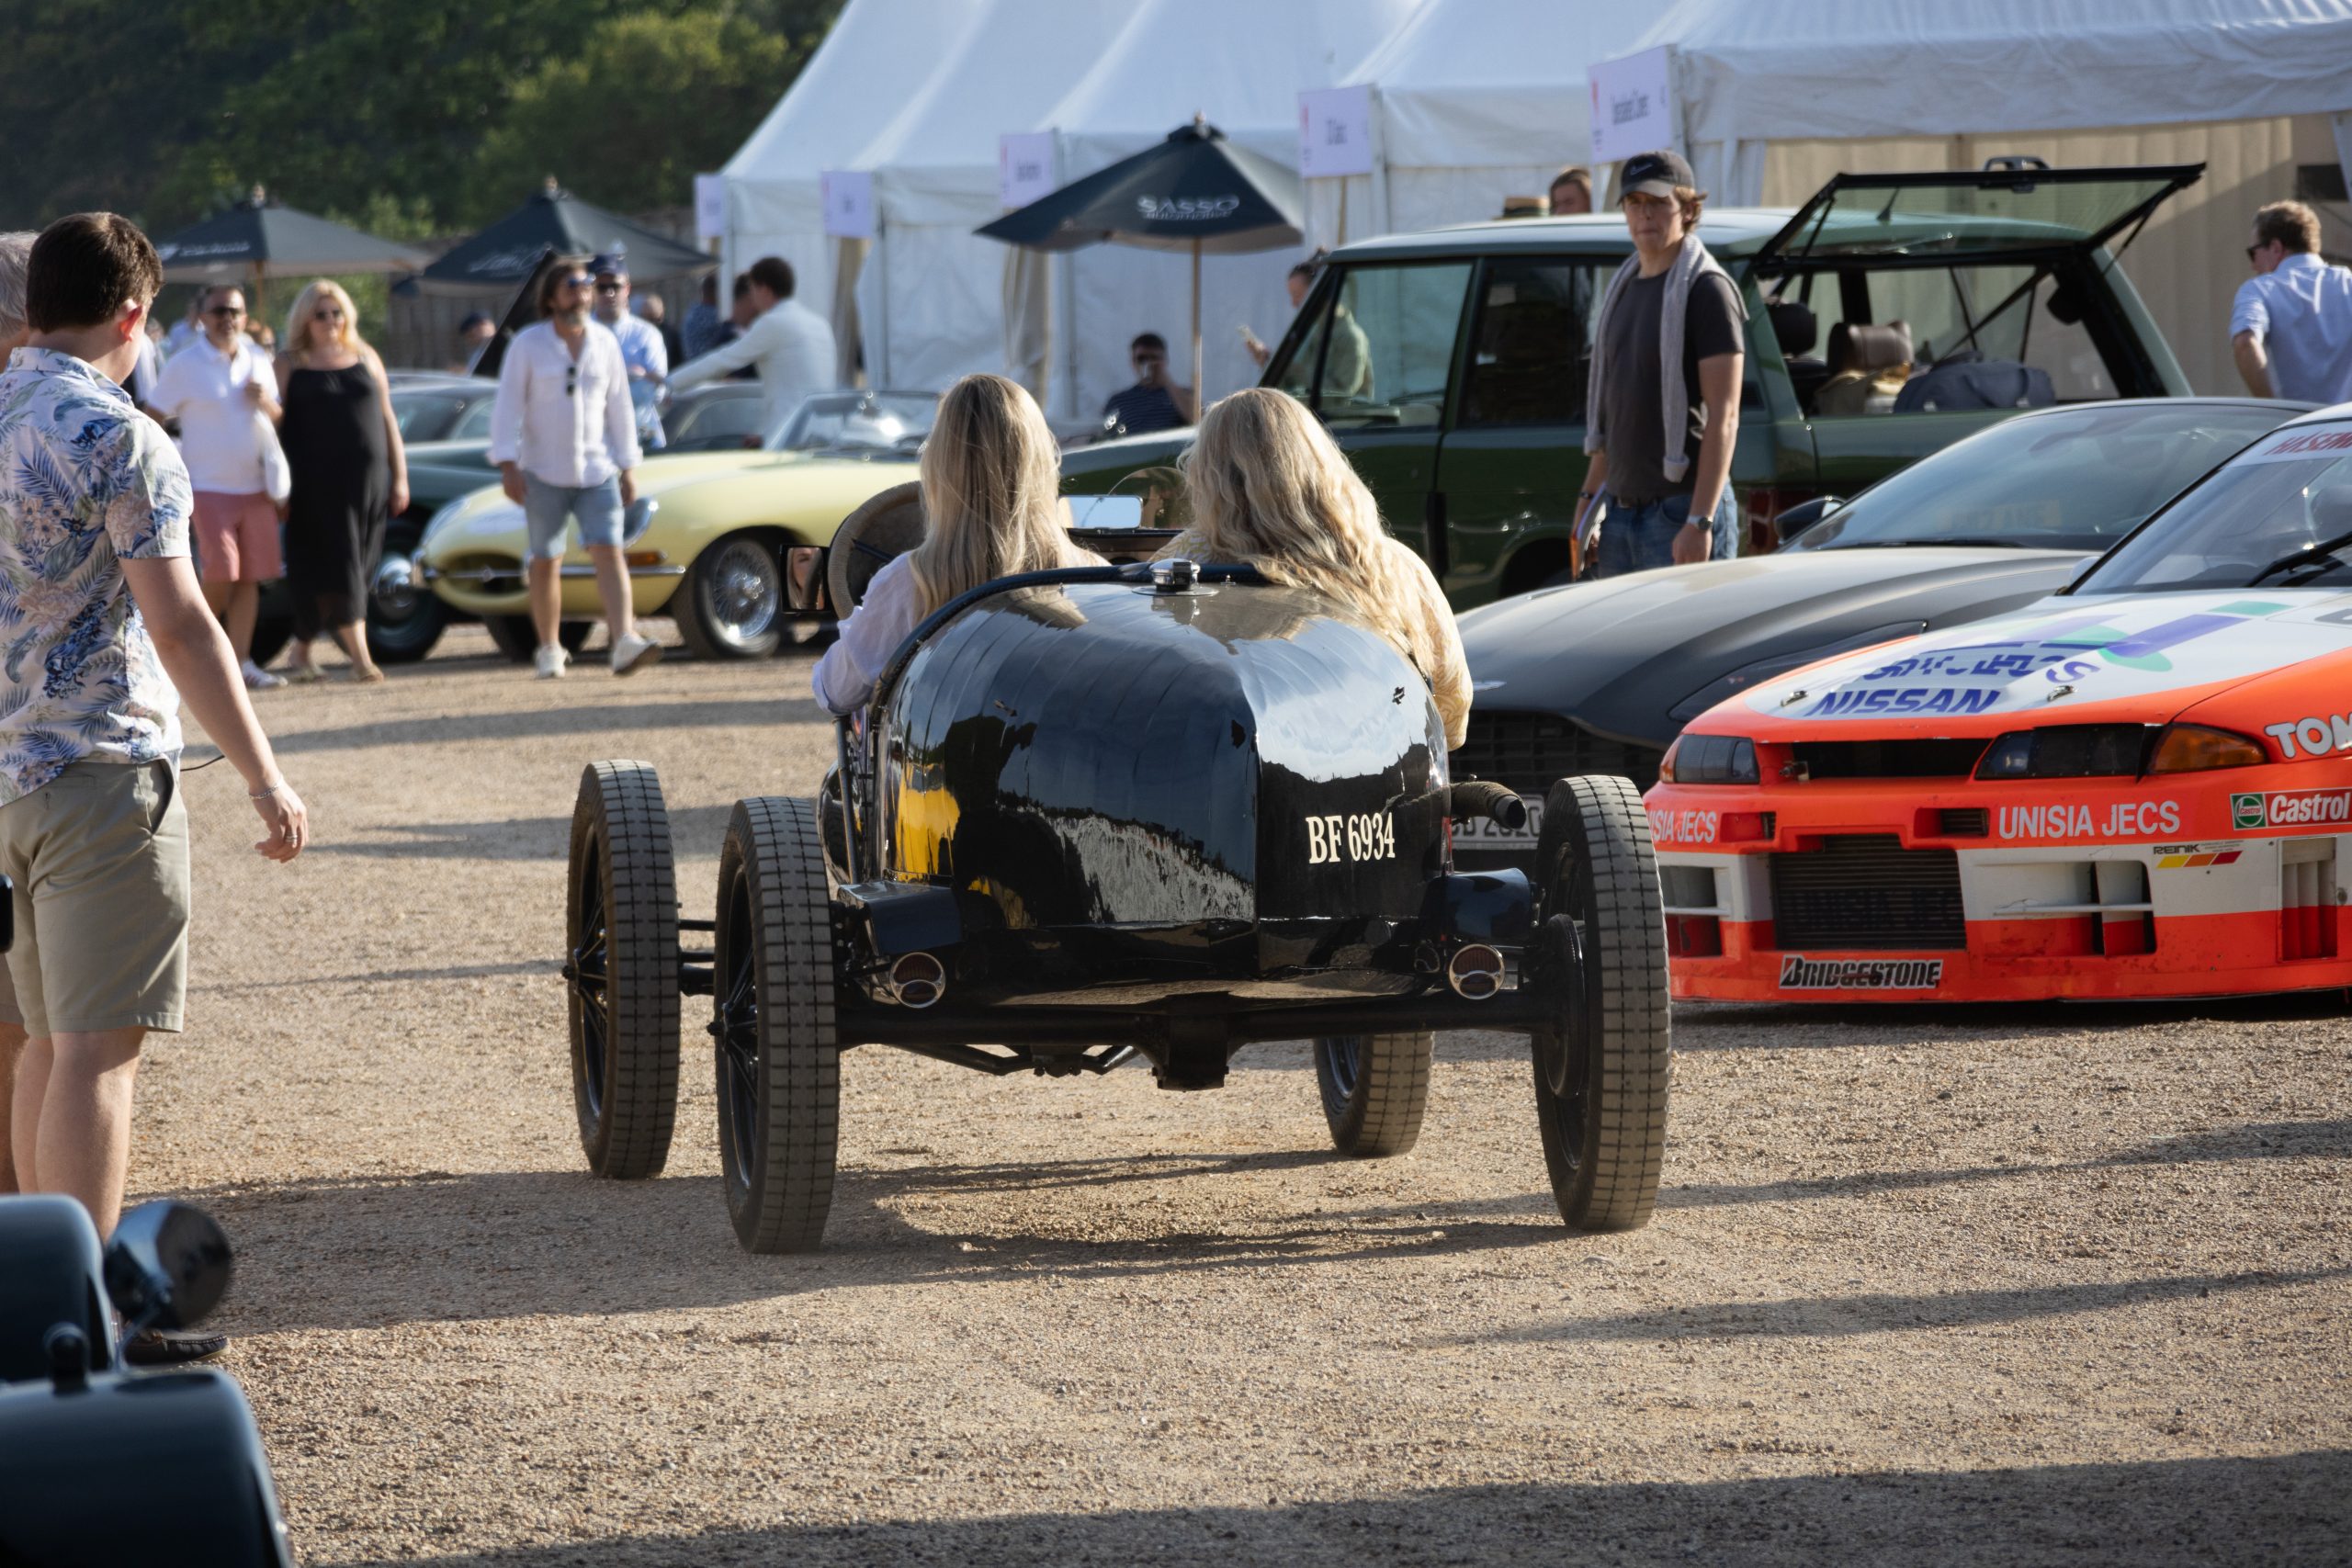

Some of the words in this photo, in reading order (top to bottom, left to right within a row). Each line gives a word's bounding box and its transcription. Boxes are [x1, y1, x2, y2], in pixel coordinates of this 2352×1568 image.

[1137, 193, 1239, 213] SASSO
[1804, 688, 2001, 717] NISSAN
[1998, 805, 2095, 840] UNISIA
[2102, 800, 2180, 837] JECS
[2270, 792, 2351, 824] Castrol
[1306, 815, 1343, 863] BF
[1348, 812, 1396, 862] 6934
[1677, 809, 1716, 843] JECS
[1780, 956, 1941, 987] BRIDGESTONE
